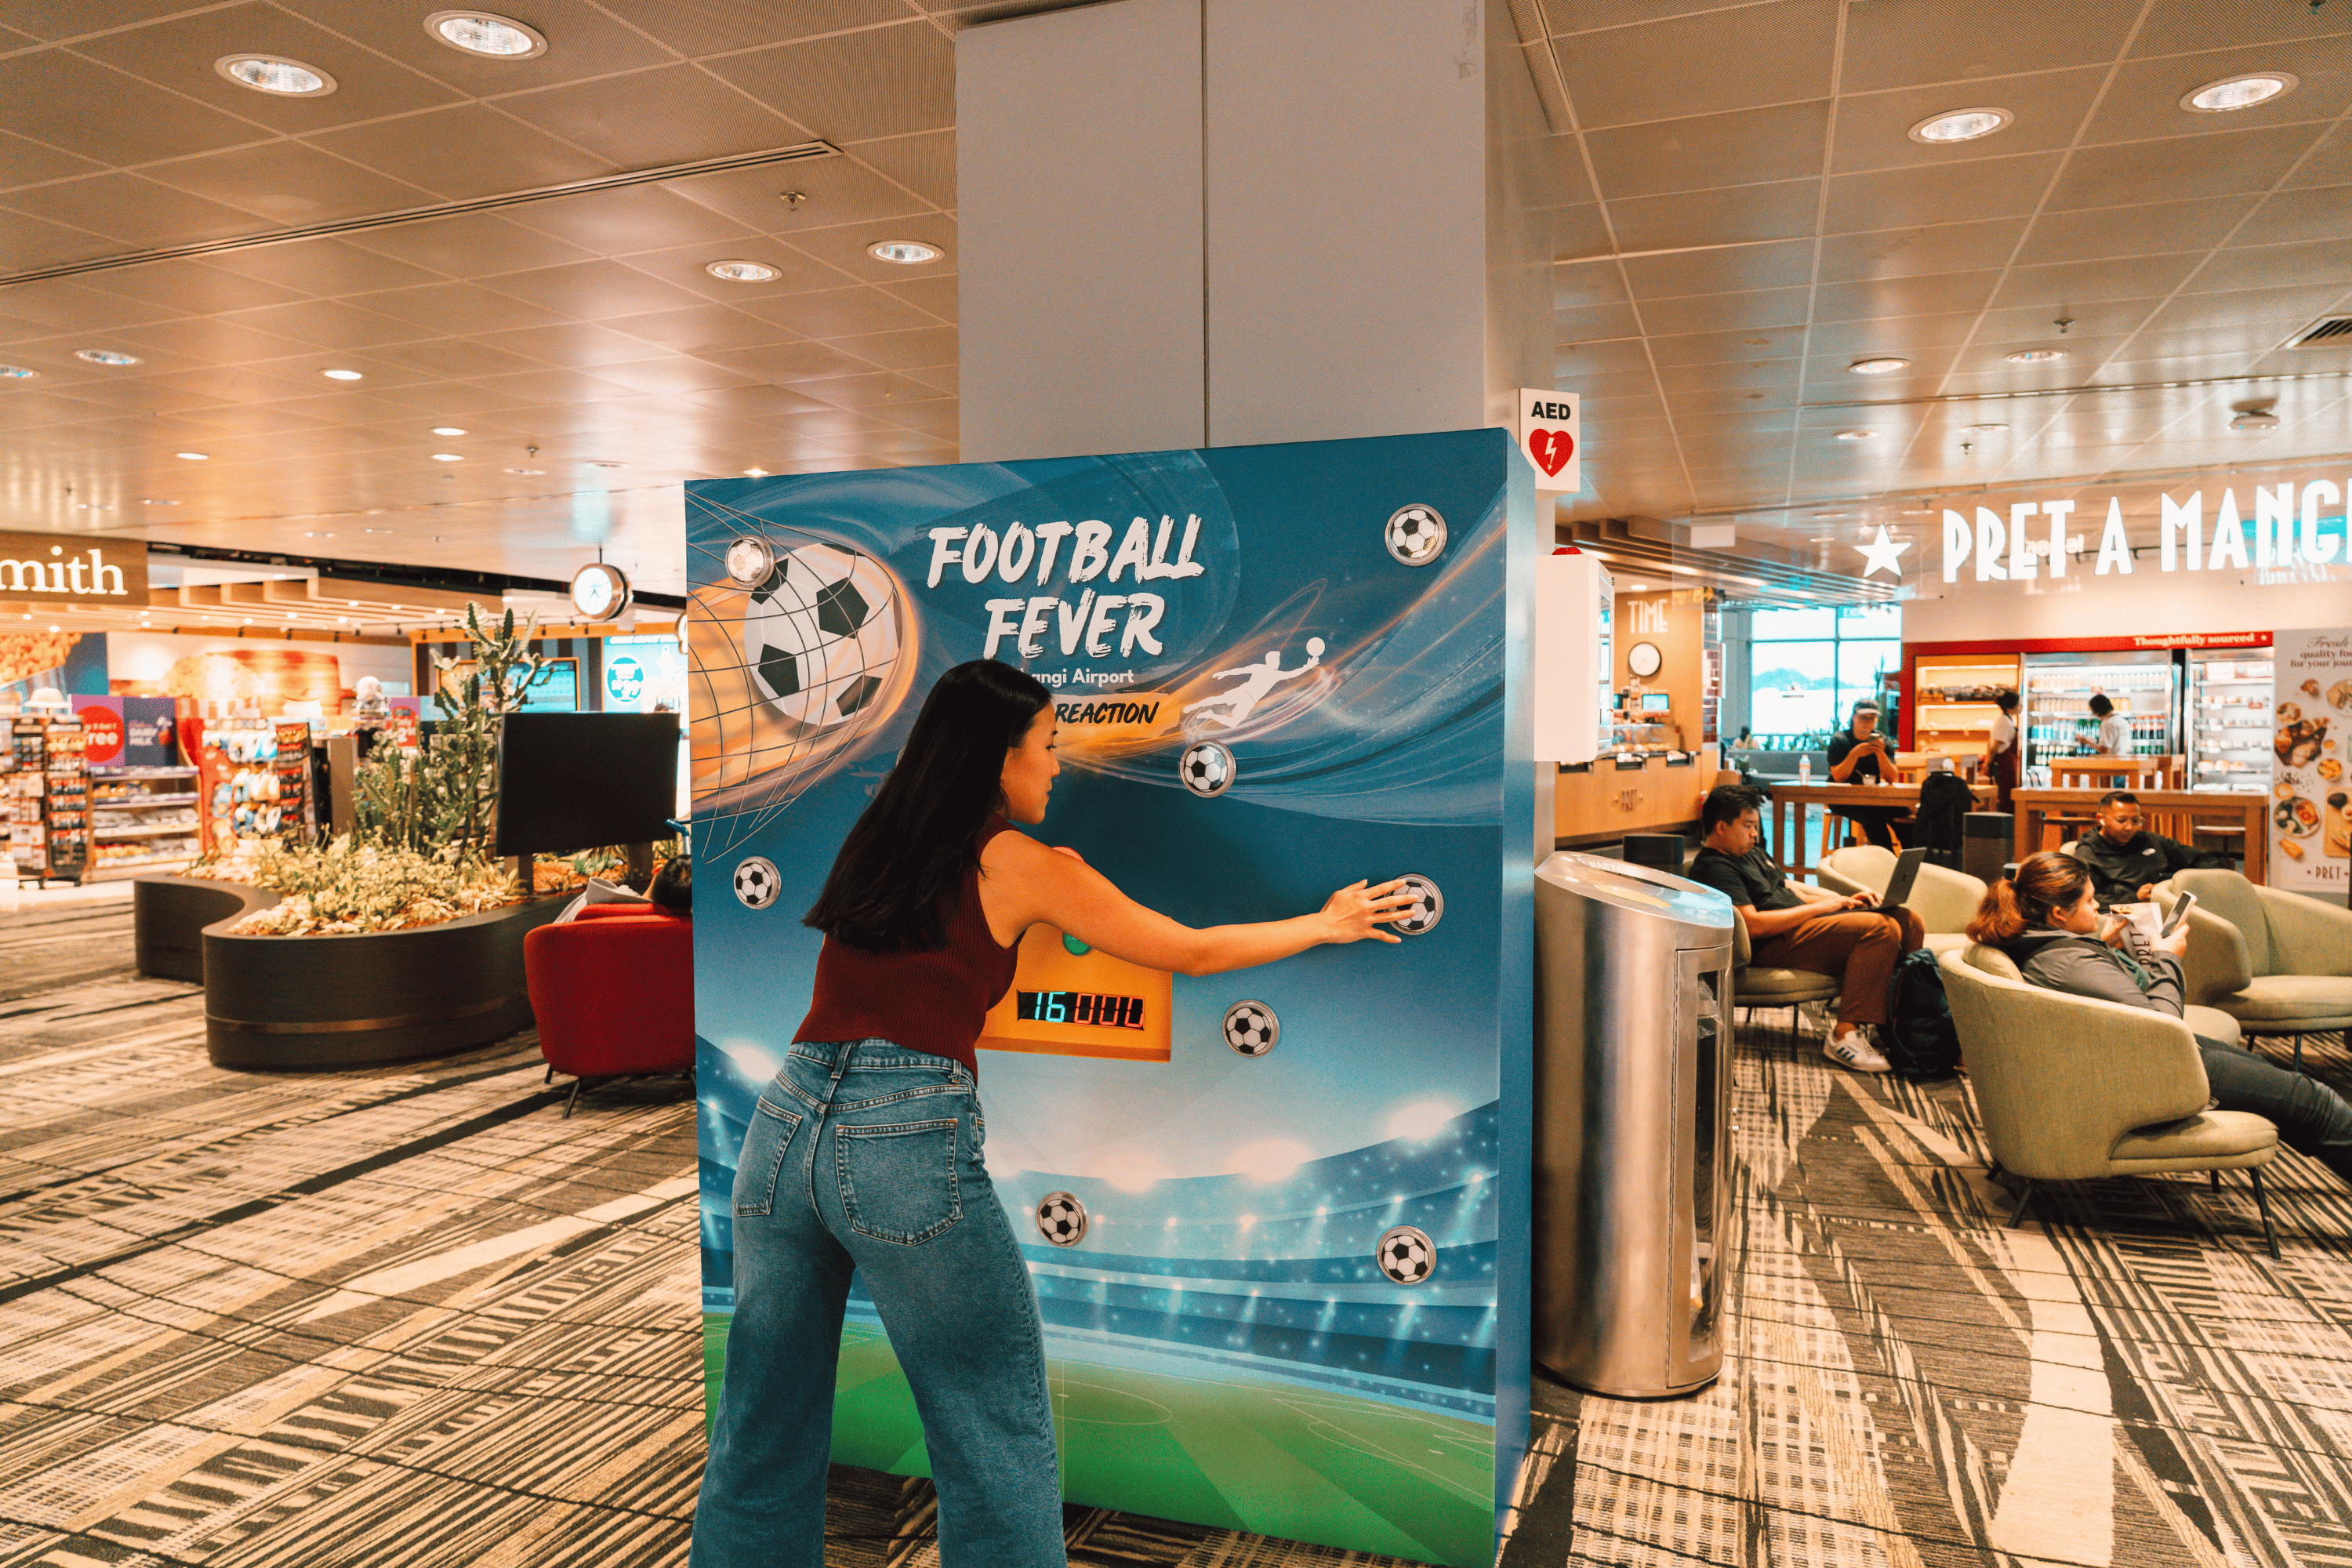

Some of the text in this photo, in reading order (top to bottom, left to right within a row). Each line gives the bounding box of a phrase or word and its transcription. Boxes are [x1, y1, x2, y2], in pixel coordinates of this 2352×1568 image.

[1531, 401, 1570, 420] AED
[1942, 499, 2075, 583] PRET
[2094, 496, 2132, 575] A
[2161, 478, 2352, 572] MANG
[927, 514, 1204, 589] FOOTBALL
[983, 587, 1165, 660] FEVER
[1627, 599, 1668, 633] TIME
[2133, 633, 2255, 647] Thoughtfully sourced
[1072, 668, 1134, 688] Airport
[1055, 701, 1160, 724] REACTION
[2315, 866, 2340, 879] PRET
[2129, 931, 2153, 965] PRET
